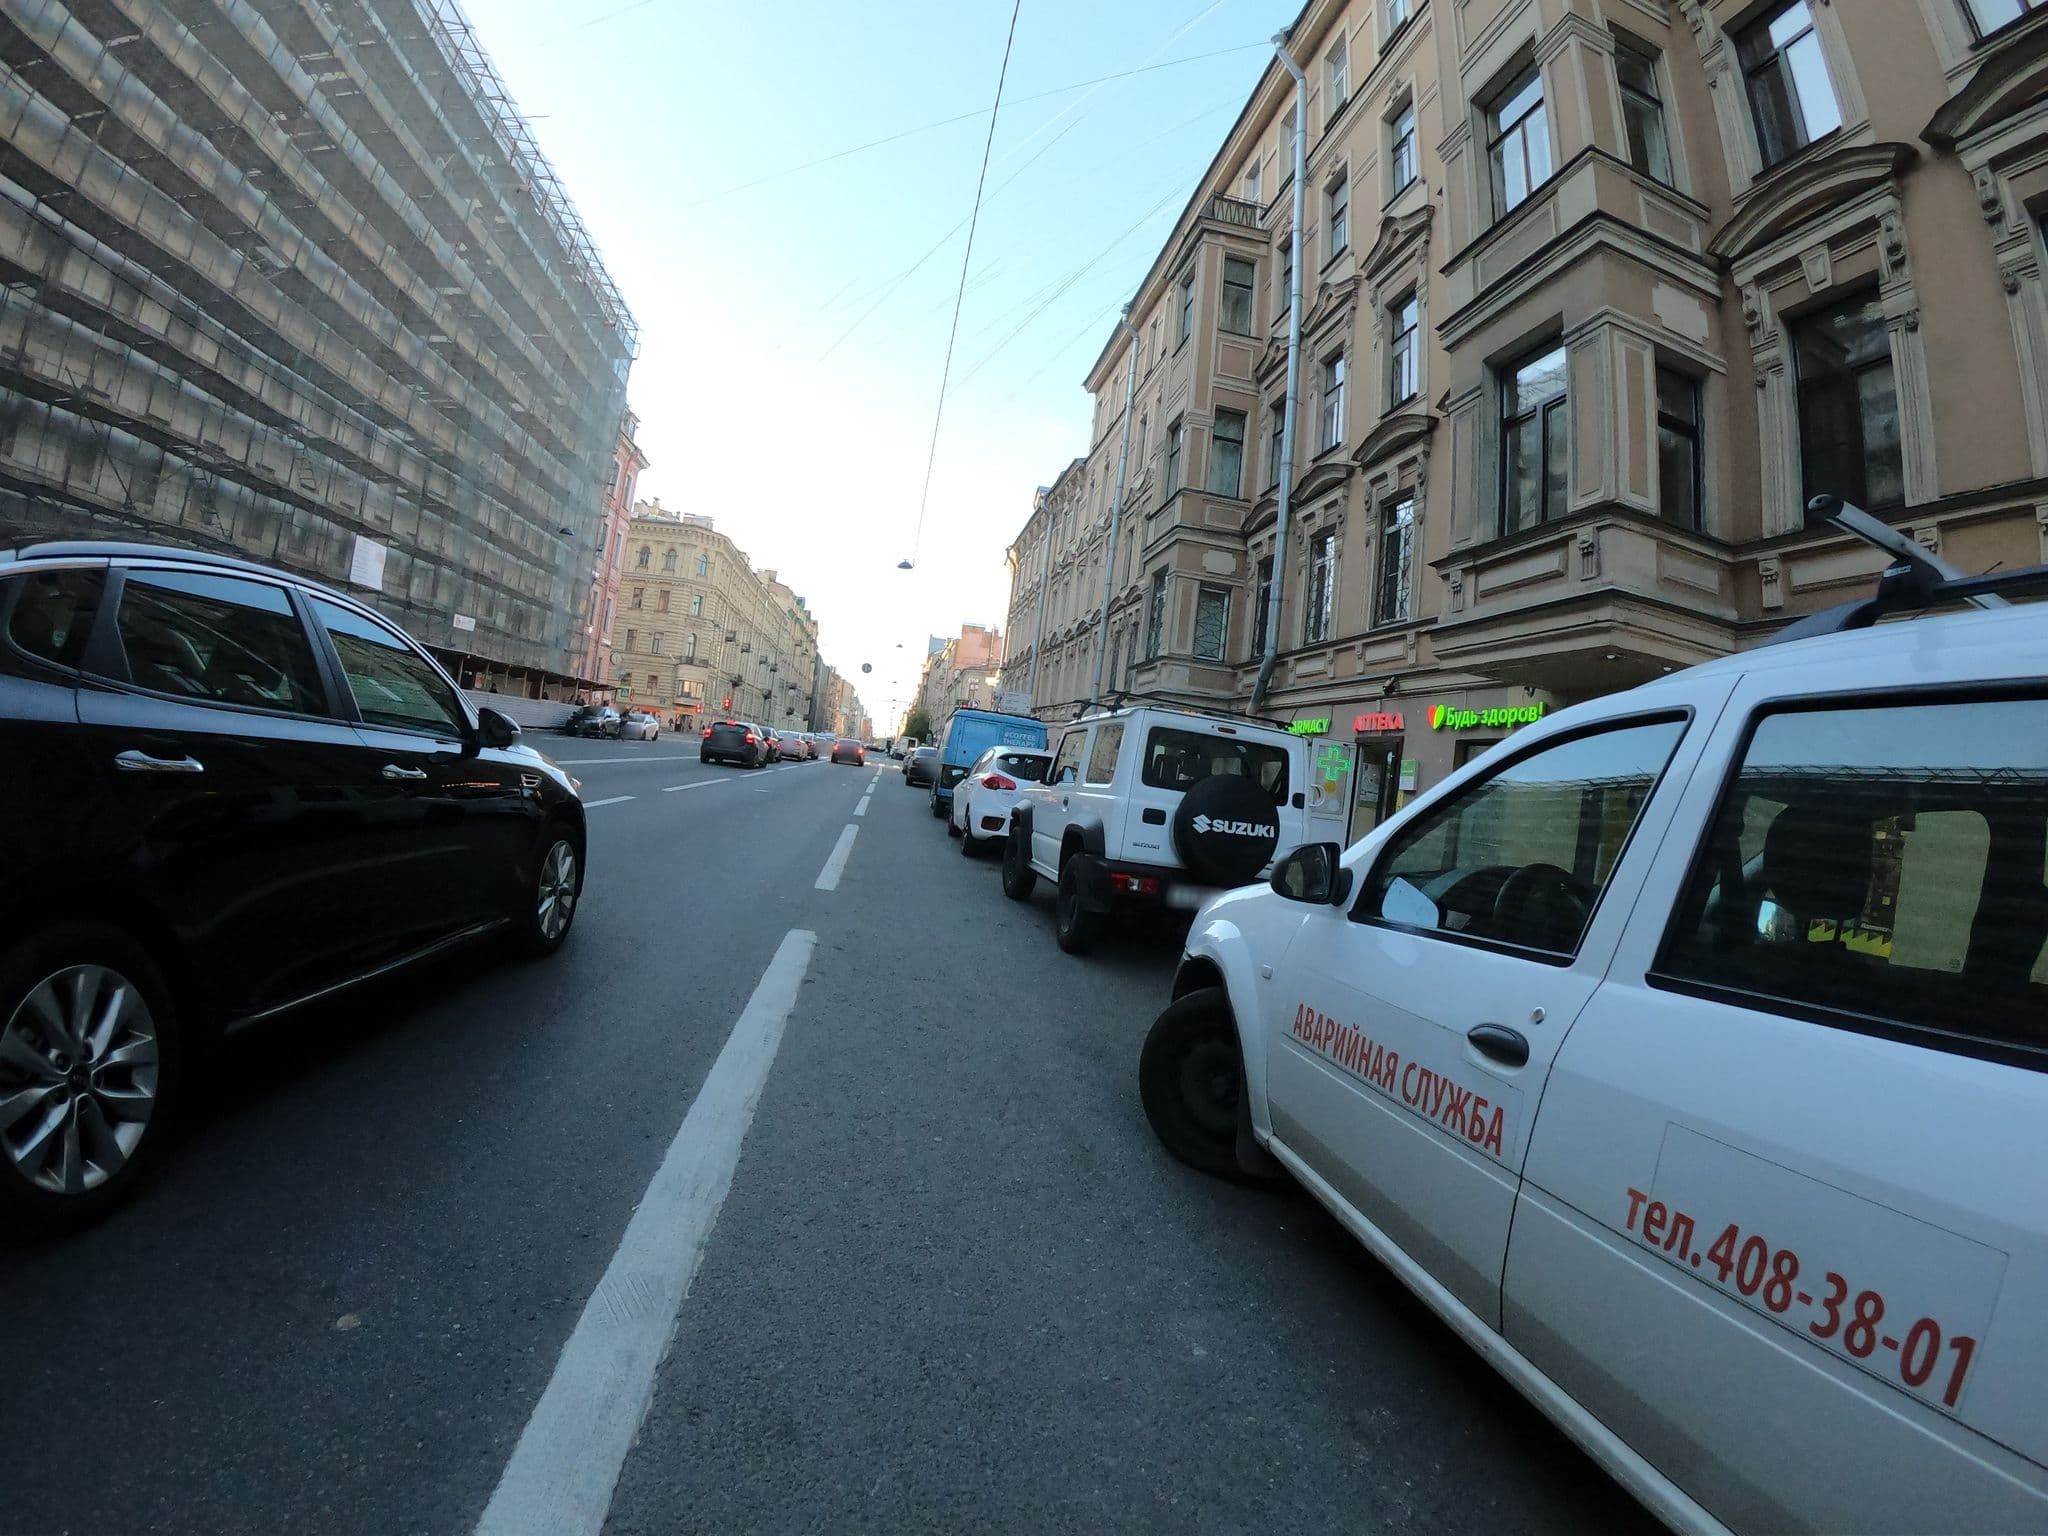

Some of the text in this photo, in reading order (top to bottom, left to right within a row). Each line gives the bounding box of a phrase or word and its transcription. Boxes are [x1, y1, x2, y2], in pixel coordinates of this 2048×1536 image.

[1353, 712, 1403, 731] АПТЕКА
[1446, 701, 1544, 730] Будь здоров!
[1288, 718, 1329, 734] ARMACY
[1003, 738, 1036, 748] THERAPY
[1211, 818, 1275, 839] SUZUKI
[1293, 1003, 1504, 1156] АВАРИЙНАЯ СЛУЖБА
